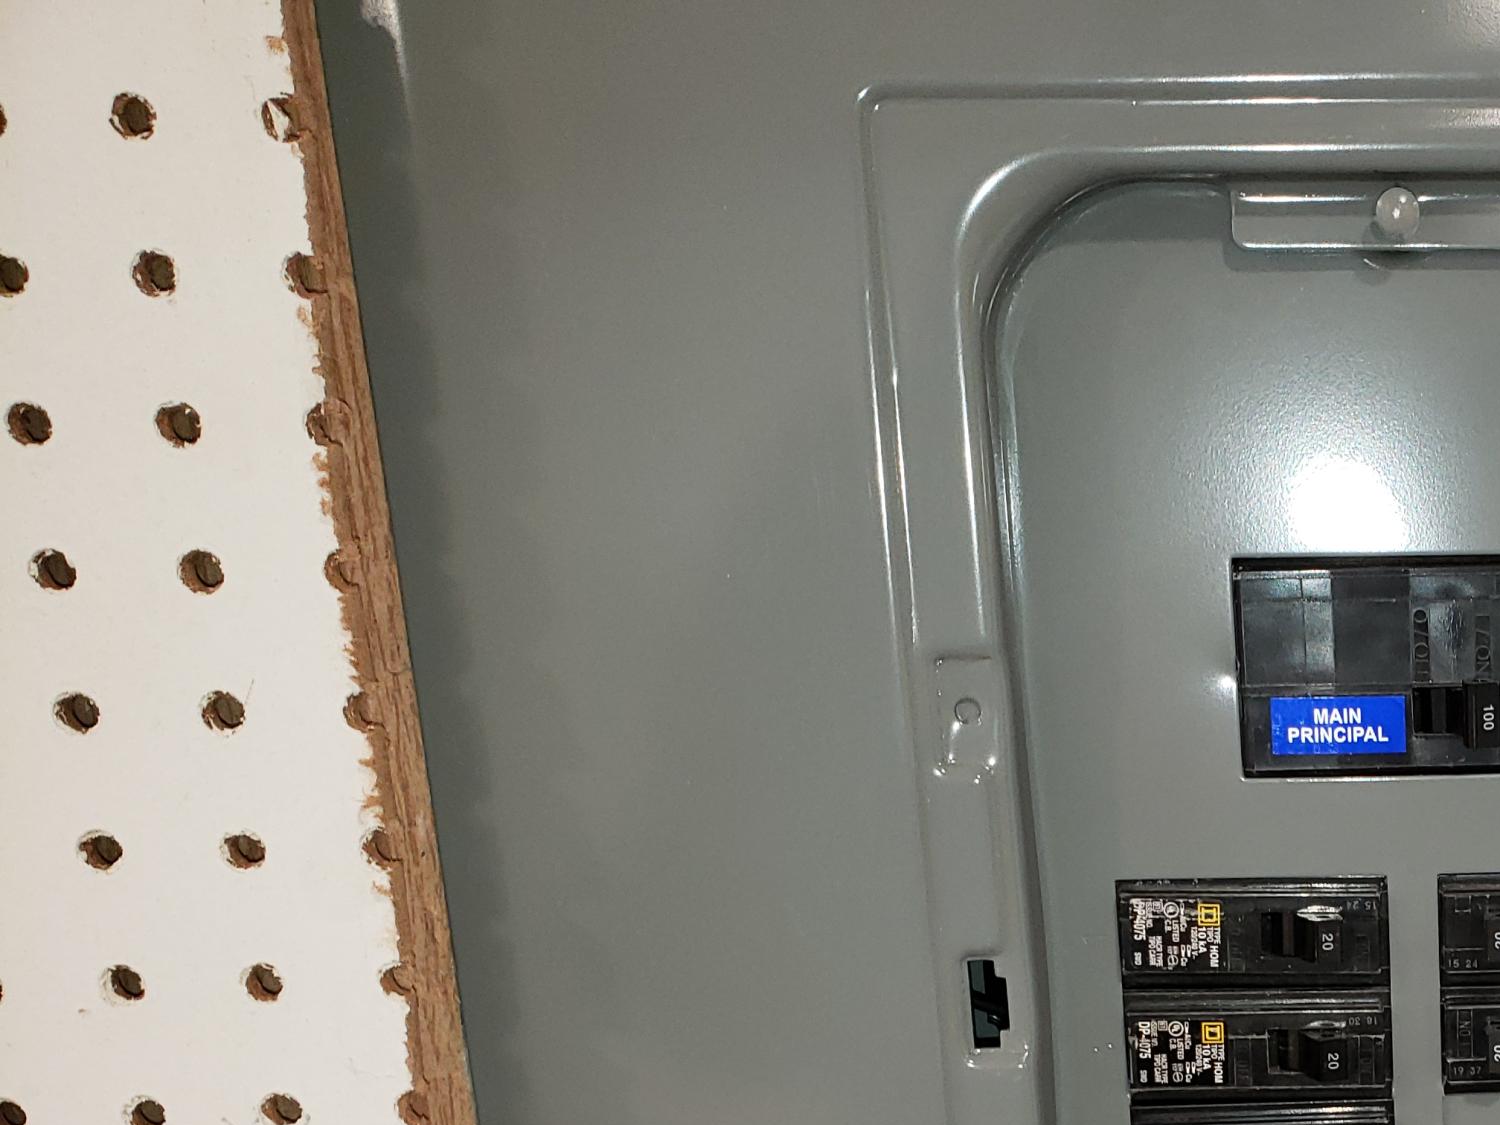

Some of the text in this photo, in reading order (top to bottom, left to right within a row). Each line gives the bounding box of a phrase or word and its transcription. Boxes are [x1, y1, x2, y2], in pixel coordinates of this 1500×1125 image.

[1314, 708, 1361, 724] MAIN
[1483, 704, 1494, 731] 100
[1288, 726, 1388, 743] PRINCIPAL
[1198, 927, 1207, 953] 10 kA
[1322, 933, 1334, 950] 20
[1210, 946, 1219, 967] HOM
[1465, 960, 1478, 968] 24
[1203, 1045, 1211, 1070] 10 kA
[1328, 1052, 1339, 1070] 20
[1214, 1062, 1223, 1083] HOM
[1453, 1067, 1481, 1075] 19 37
